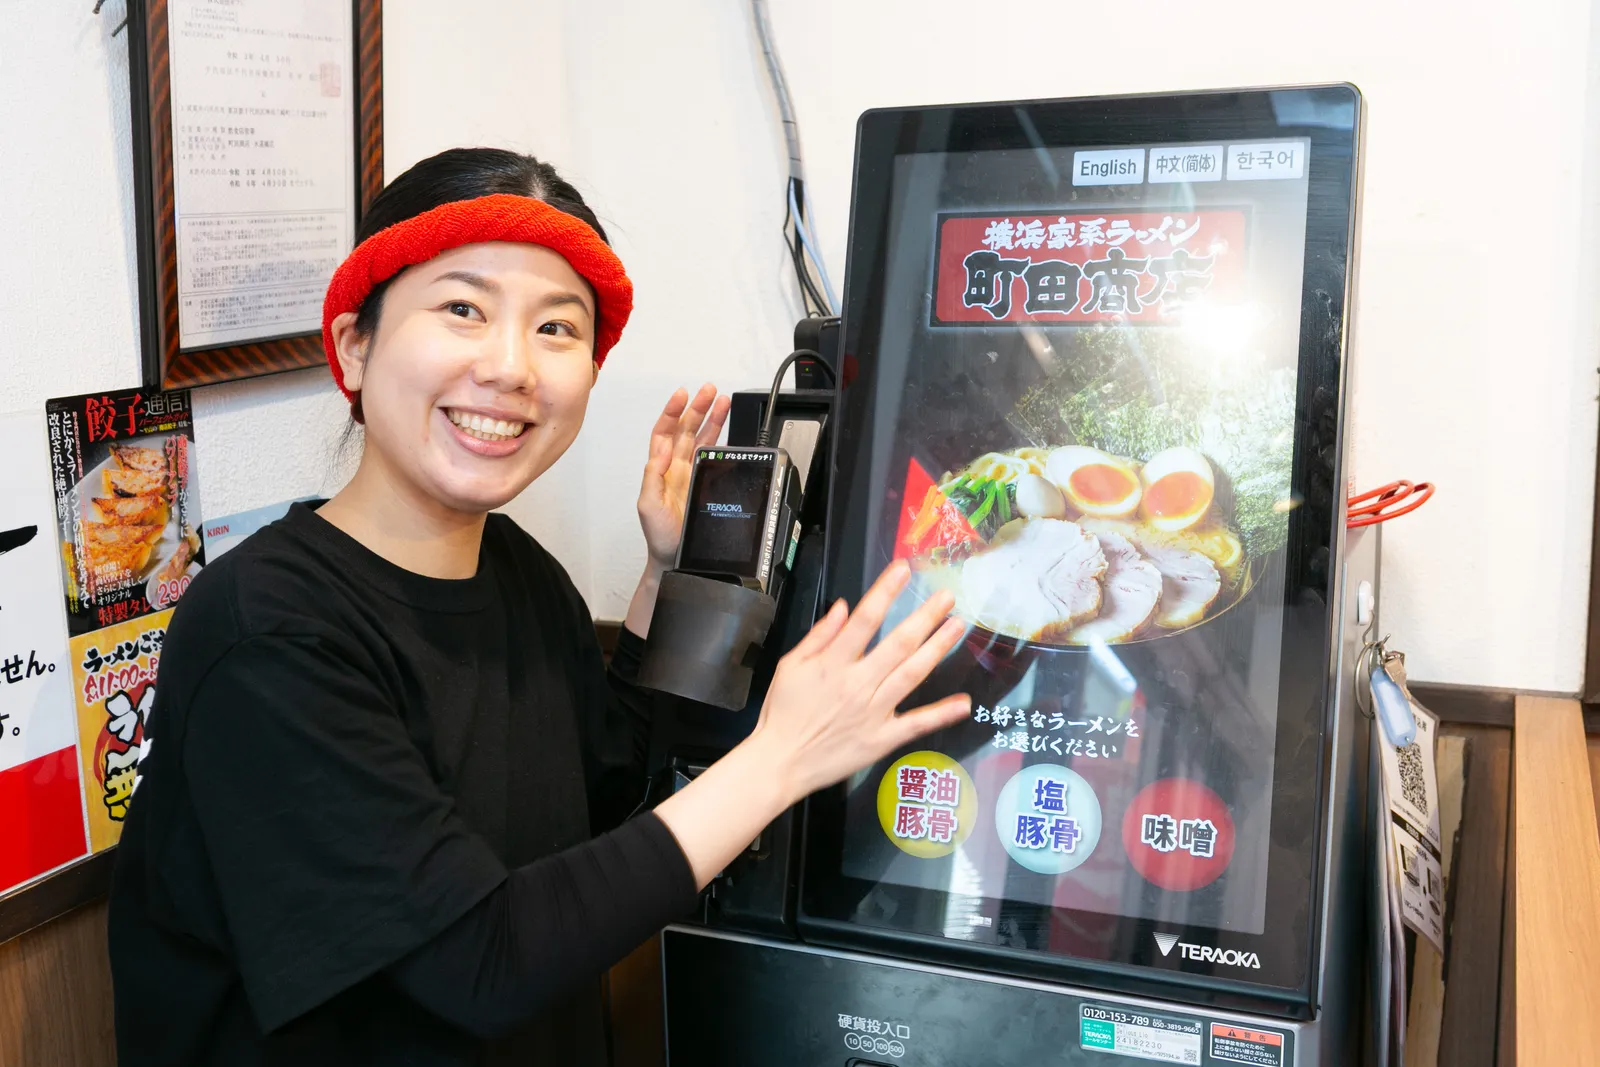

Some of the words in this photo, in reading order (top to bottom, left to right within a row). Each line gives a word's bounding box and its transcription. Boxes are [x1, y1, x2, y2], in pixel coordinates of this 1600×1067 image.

[1080, 158, 1137, 178] English
[1156, 153, 1216, 175] 中文(简体)
[1236, 148, 1295, 171] 한국어
[982, 215, 1201, 251] 横浜家系ラーメン
[706, 502, 743, 512] TERAOKA
[207, 524, 229, 538] KIRIN
[96, 576, 142, 596] さらに美味しく
[97, 589, 132, 606] オリジナル
[98, 596, 153, 627] 特製タレ
[0, 650, 56, 684] せん。
[973, 704, 1141, 738] お好きなラーメンを
[991, 731, 1117, 759] お選びください
[898, 766, 961, 805] 醤油
[1033, 778, 1067, 815] 塩
[895, 803, 957, 842] 豚骨
[1014, 814, 1080, 852] 豚骨
[1141, 814, 1218, 859] 味噌
[1178, 942, 1261, 969] TERAOKA
[838, 1013, 910, 1039] 硬貨投入口
[1083, 1008, 1149, 1026] 0120-153-789
[1152, 1021, 1199, 1034] 050-3819-9665
[849, 1037, 858, 1045] 10
[862, 1040, 872, 1048] 50
[876, 1042, 888, 1051] 100
[890, 1045, 903, 1054] 500
[1084, 1030, 1112, 1041] TERAOKA
[1116, 1036, 1162, 1050] 24182230
